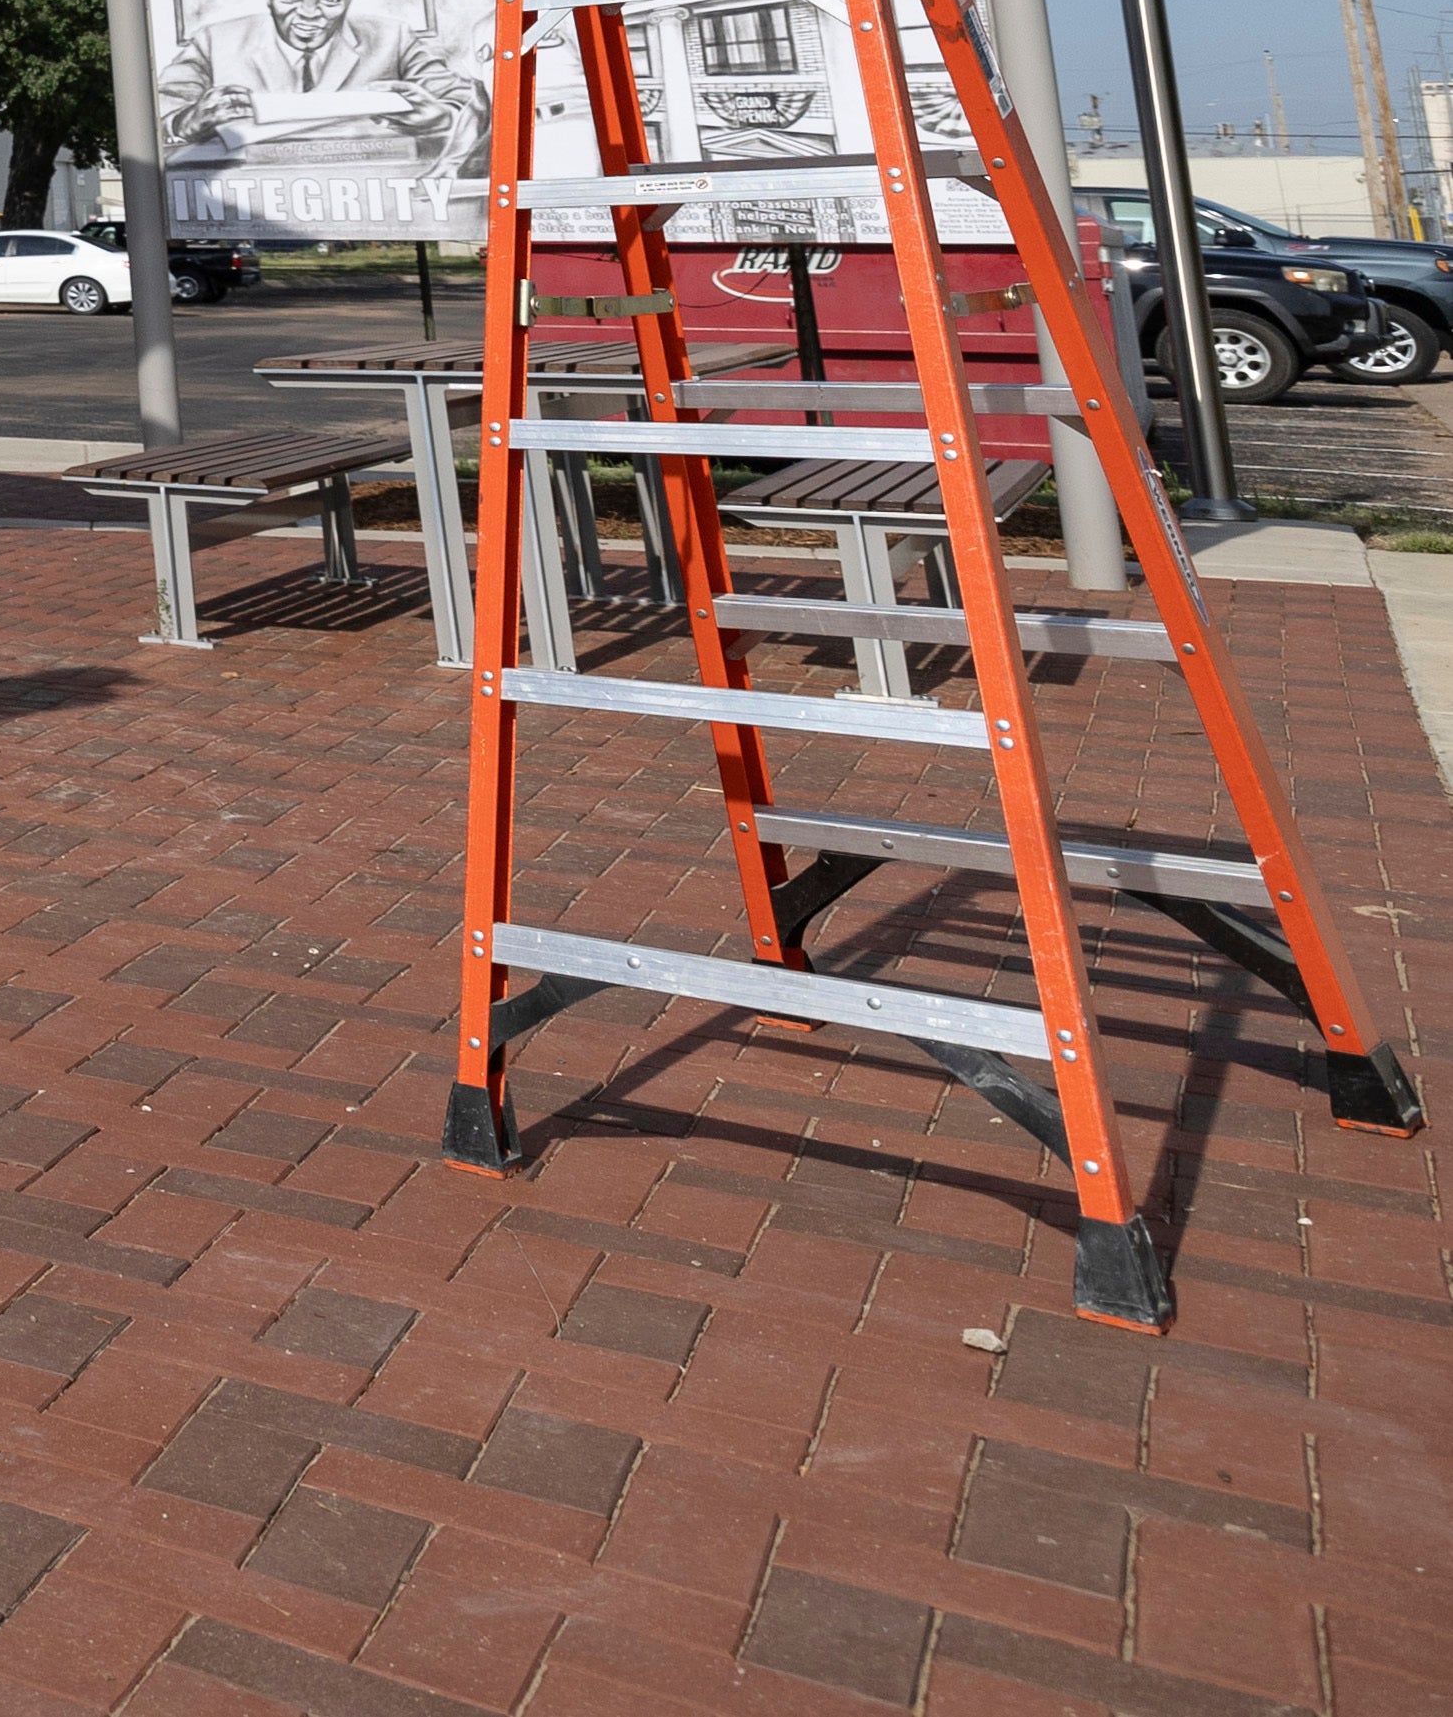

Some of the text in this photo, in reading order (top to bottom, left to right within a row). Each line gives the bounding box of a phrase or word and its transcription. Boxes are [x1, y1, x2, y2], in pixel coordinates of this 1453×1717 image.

[735, 96, 771, 109] GRAND
[172, 177, 455, 223] INTEGRITY
[758, 198, 818, 209] baseball
[738, 210, 786, 222] helped
[792, 211, 808, 220] to
[813, 211, 849, 222] open
[855, 211, 881, 221] the
[664, 223, 720, 235] perated
[728, 224, 760, 234] bank
[765, 224, 779, 234] in
[784, 224, 817, 234] New
